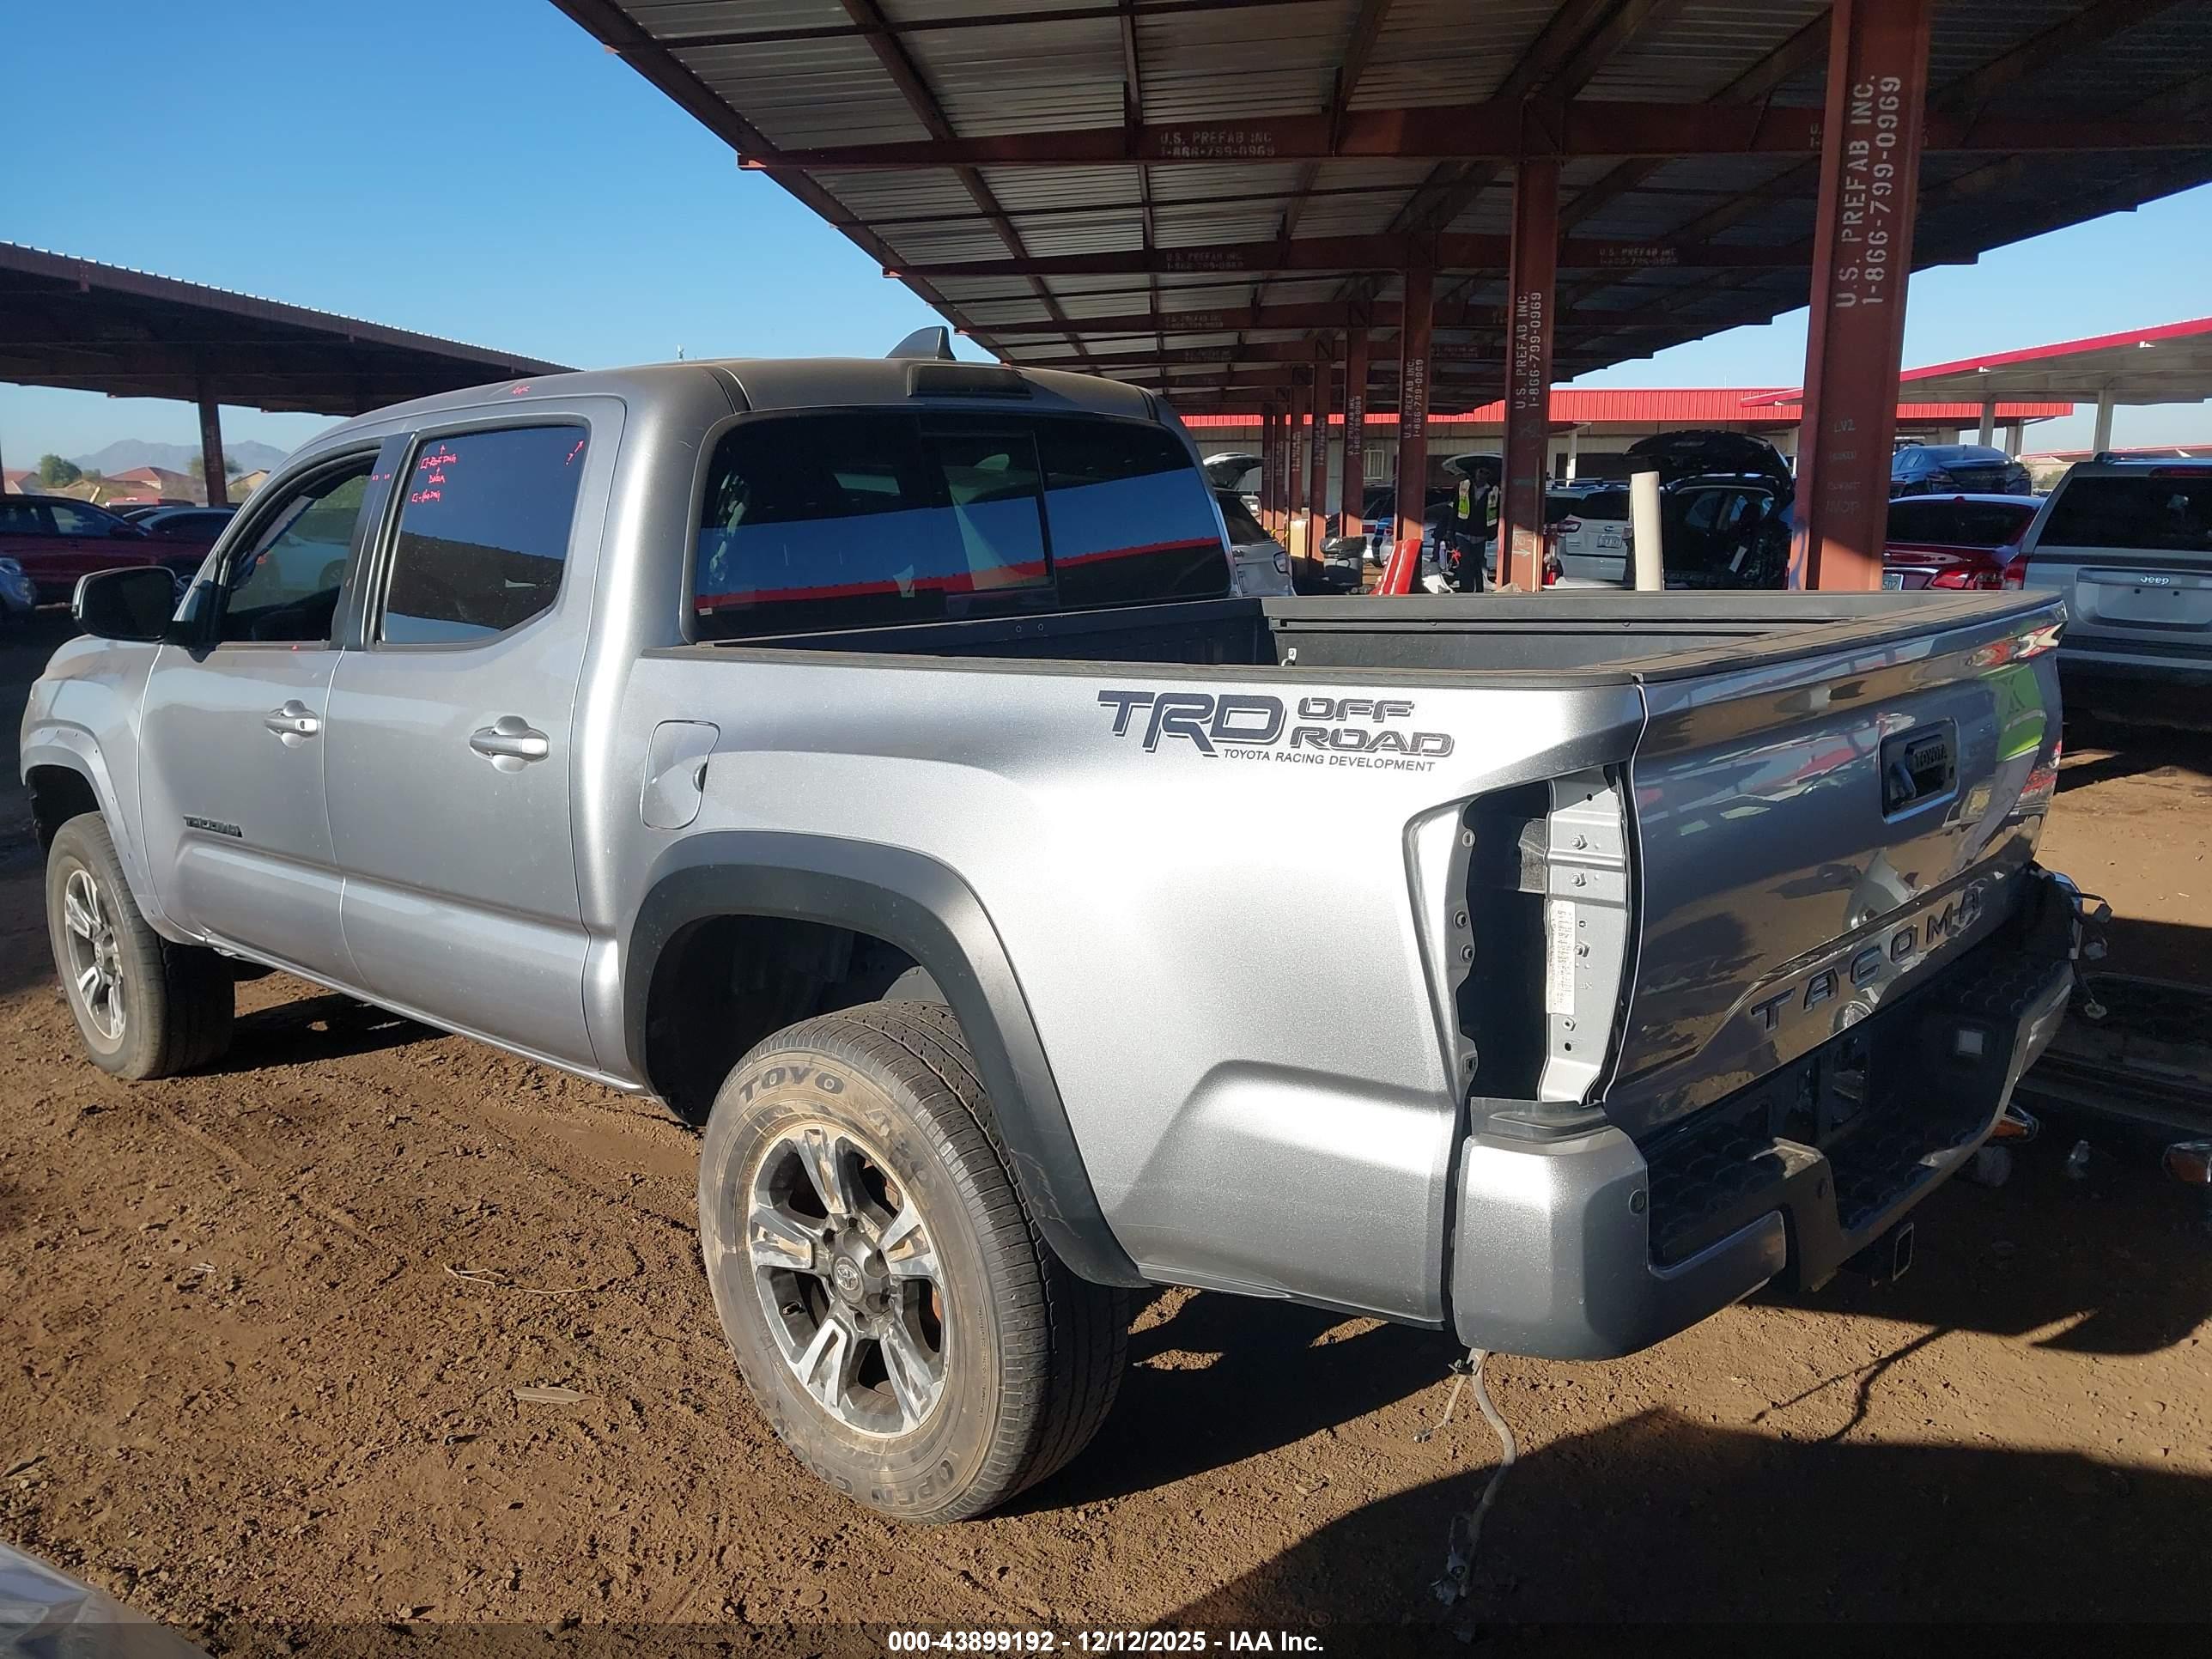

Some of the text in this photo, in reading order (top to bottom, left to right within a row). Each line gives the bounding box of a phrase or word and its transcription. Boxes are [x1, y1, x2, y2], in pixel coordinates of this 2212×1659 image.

[1192, 131, 1244, 145] PREFAB
[1835, 75, 1875, 307] U.S. PREFAB INC.
[1862, 76, 1901, 304] 1-866-799-0969
[1516, 291, 1528, 317] INC.
[1516, 324, 1528, 376] PREFAB
[1528, 292, 1542, 407] 1-866-799-0969
[2140, 576, 2169, 586] Jeep
[1097, 690, 1287, 758] TRD
[1297, 696, 1415, 723] OFF
[1223, 748, 1436, 772] TOYOTA RACING DEVELOPMENT
[1290, 726, 1455, 757] ROAD
[1750, 885, 1982, 1032] TACOMA
[738, 1065, 846, 1103] TOYO
[872, 1459, 955, 1506] OPEN
